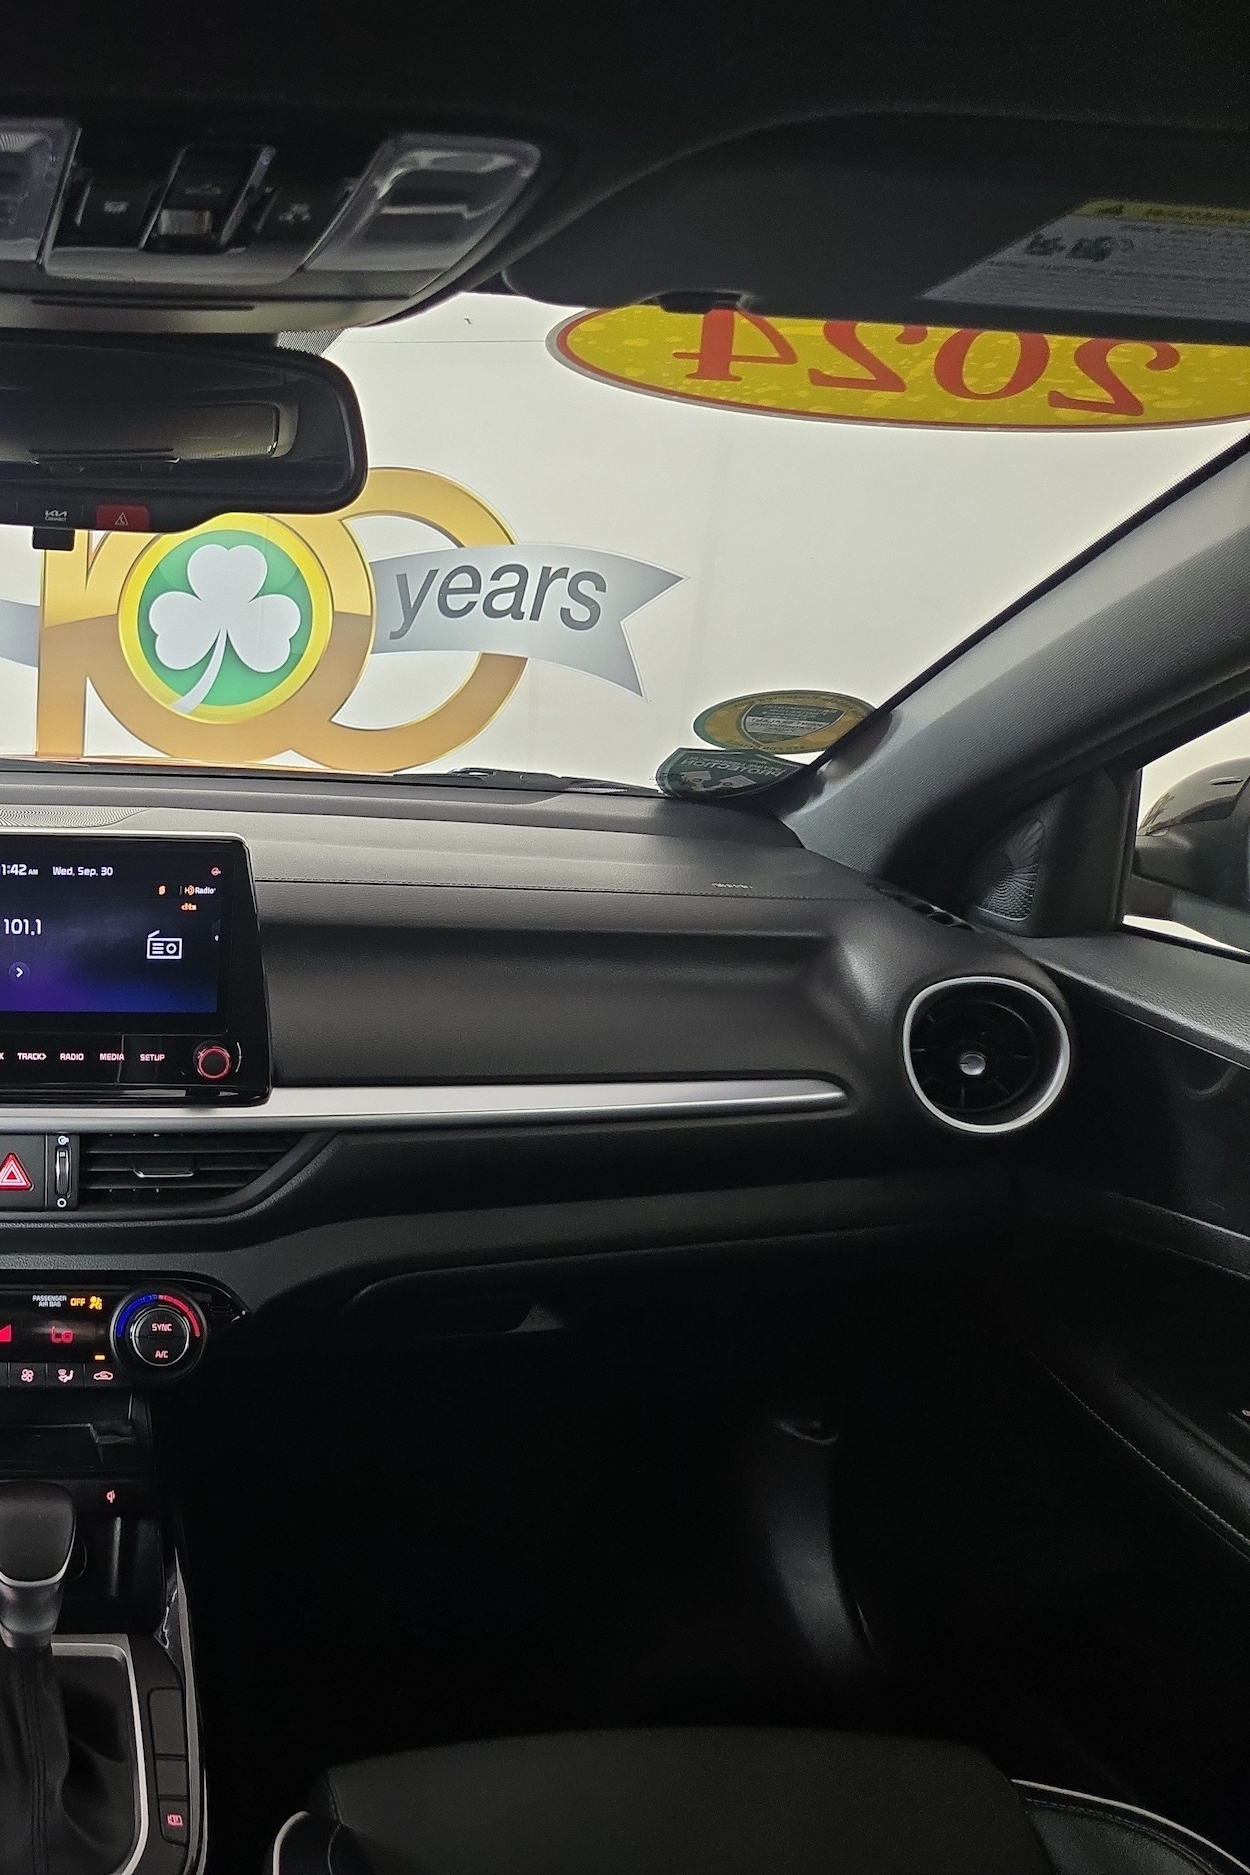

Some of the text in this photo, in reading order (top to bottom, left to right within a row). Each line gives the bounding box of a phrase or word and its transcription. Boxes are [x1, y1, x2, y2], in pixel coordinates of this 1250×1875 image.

[388, 561, 609, 641] years
[28, 868, 39, 876] AM
[77, 866, 99, 877] Sep.
[100, 866, 113, 876] 30
[3, 918, 42, 936] 101.1
[60, 1053, 84, 1061] RADIO
[100, 1053, 125, 1061] MEDIA
[140, 1053, 165, 1061] SETUP
[70, 1298, 86, 1307] OFF
[152, 1323, 173, 1332] SYNC
[50, 1326, 74, 1343] Lo
[155, 1350, 169, 1358] A/C
